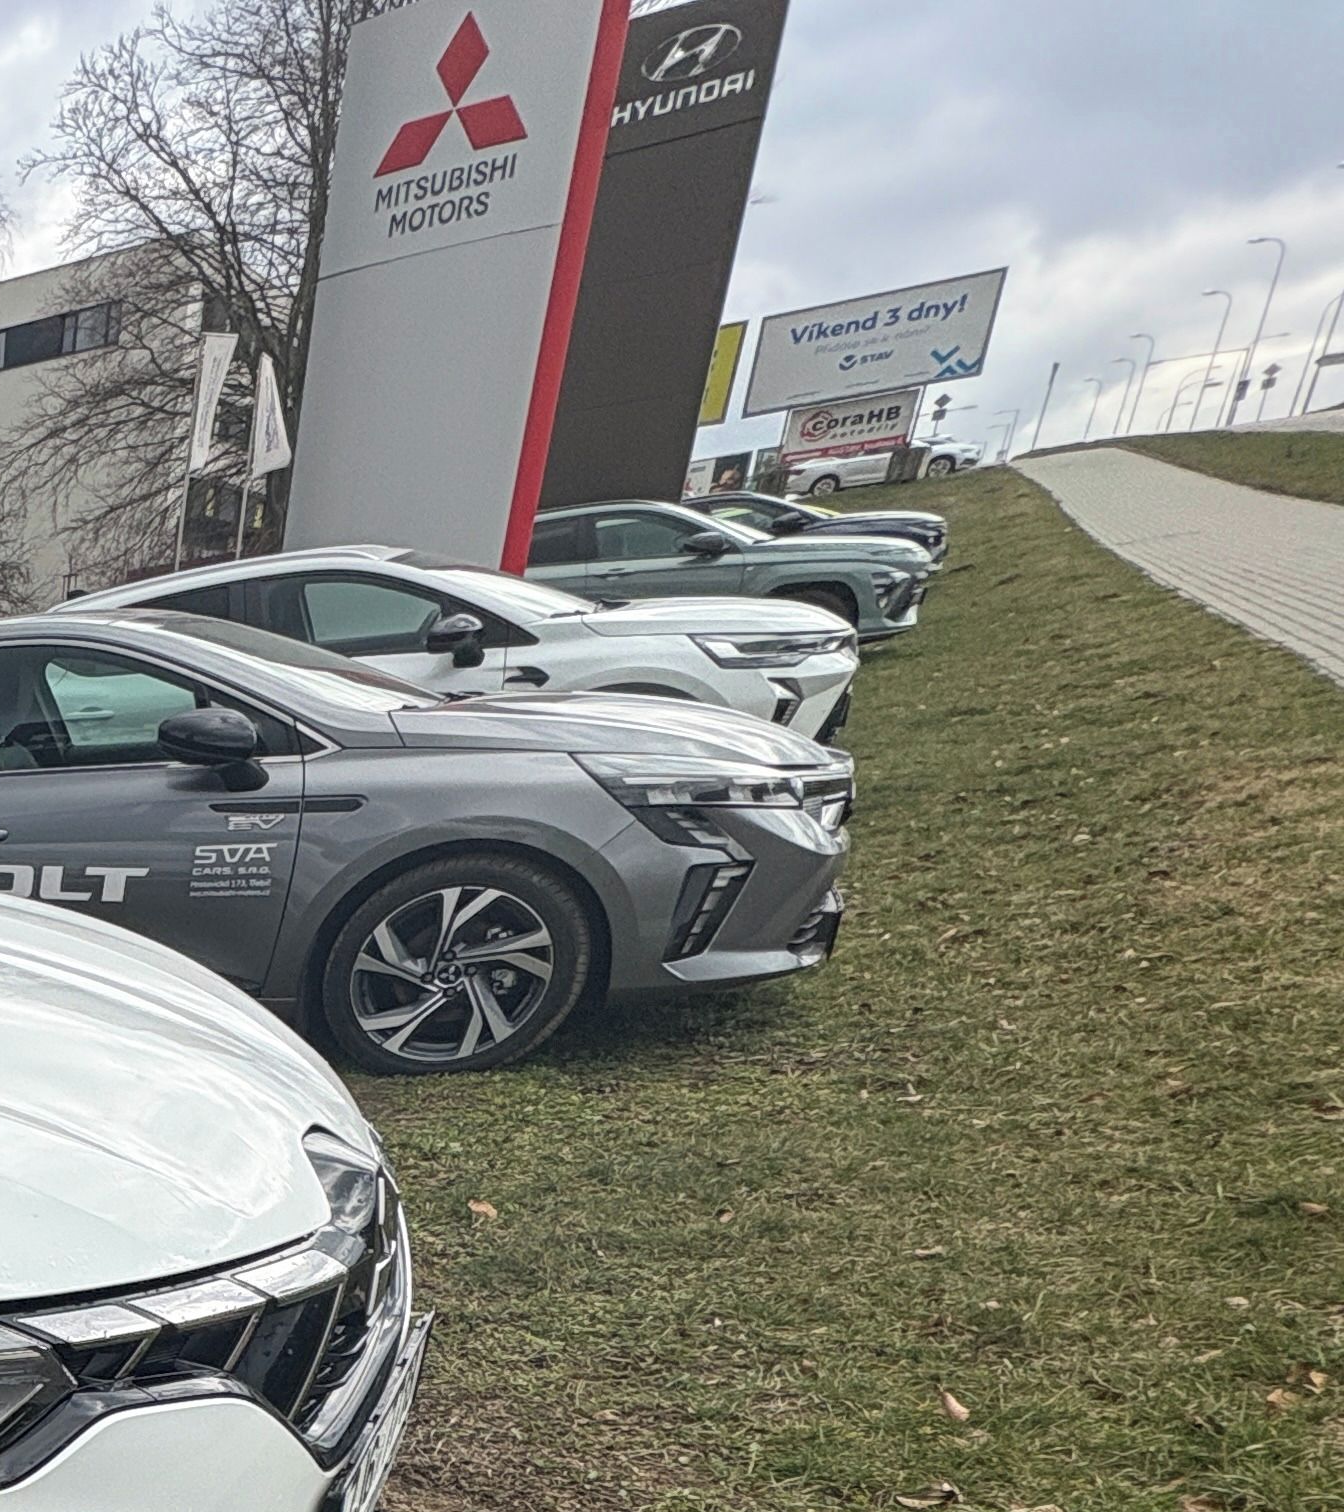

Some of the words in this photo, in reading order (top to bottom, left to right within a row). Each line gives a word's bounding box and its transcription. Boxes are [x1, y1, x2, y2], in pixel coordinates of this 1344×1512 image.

[611, 69, 755, 129] HYUNDAI
[375, 153, 518, 213] MITSUBISHI
[388, 191, 491, 238] MOTORS
[790, 310, 879, 345] Víkend
[884, 307, 903, 326] 3
[907, 293, 968, 321] dny!
[193, 842, 279, 864] SVA
